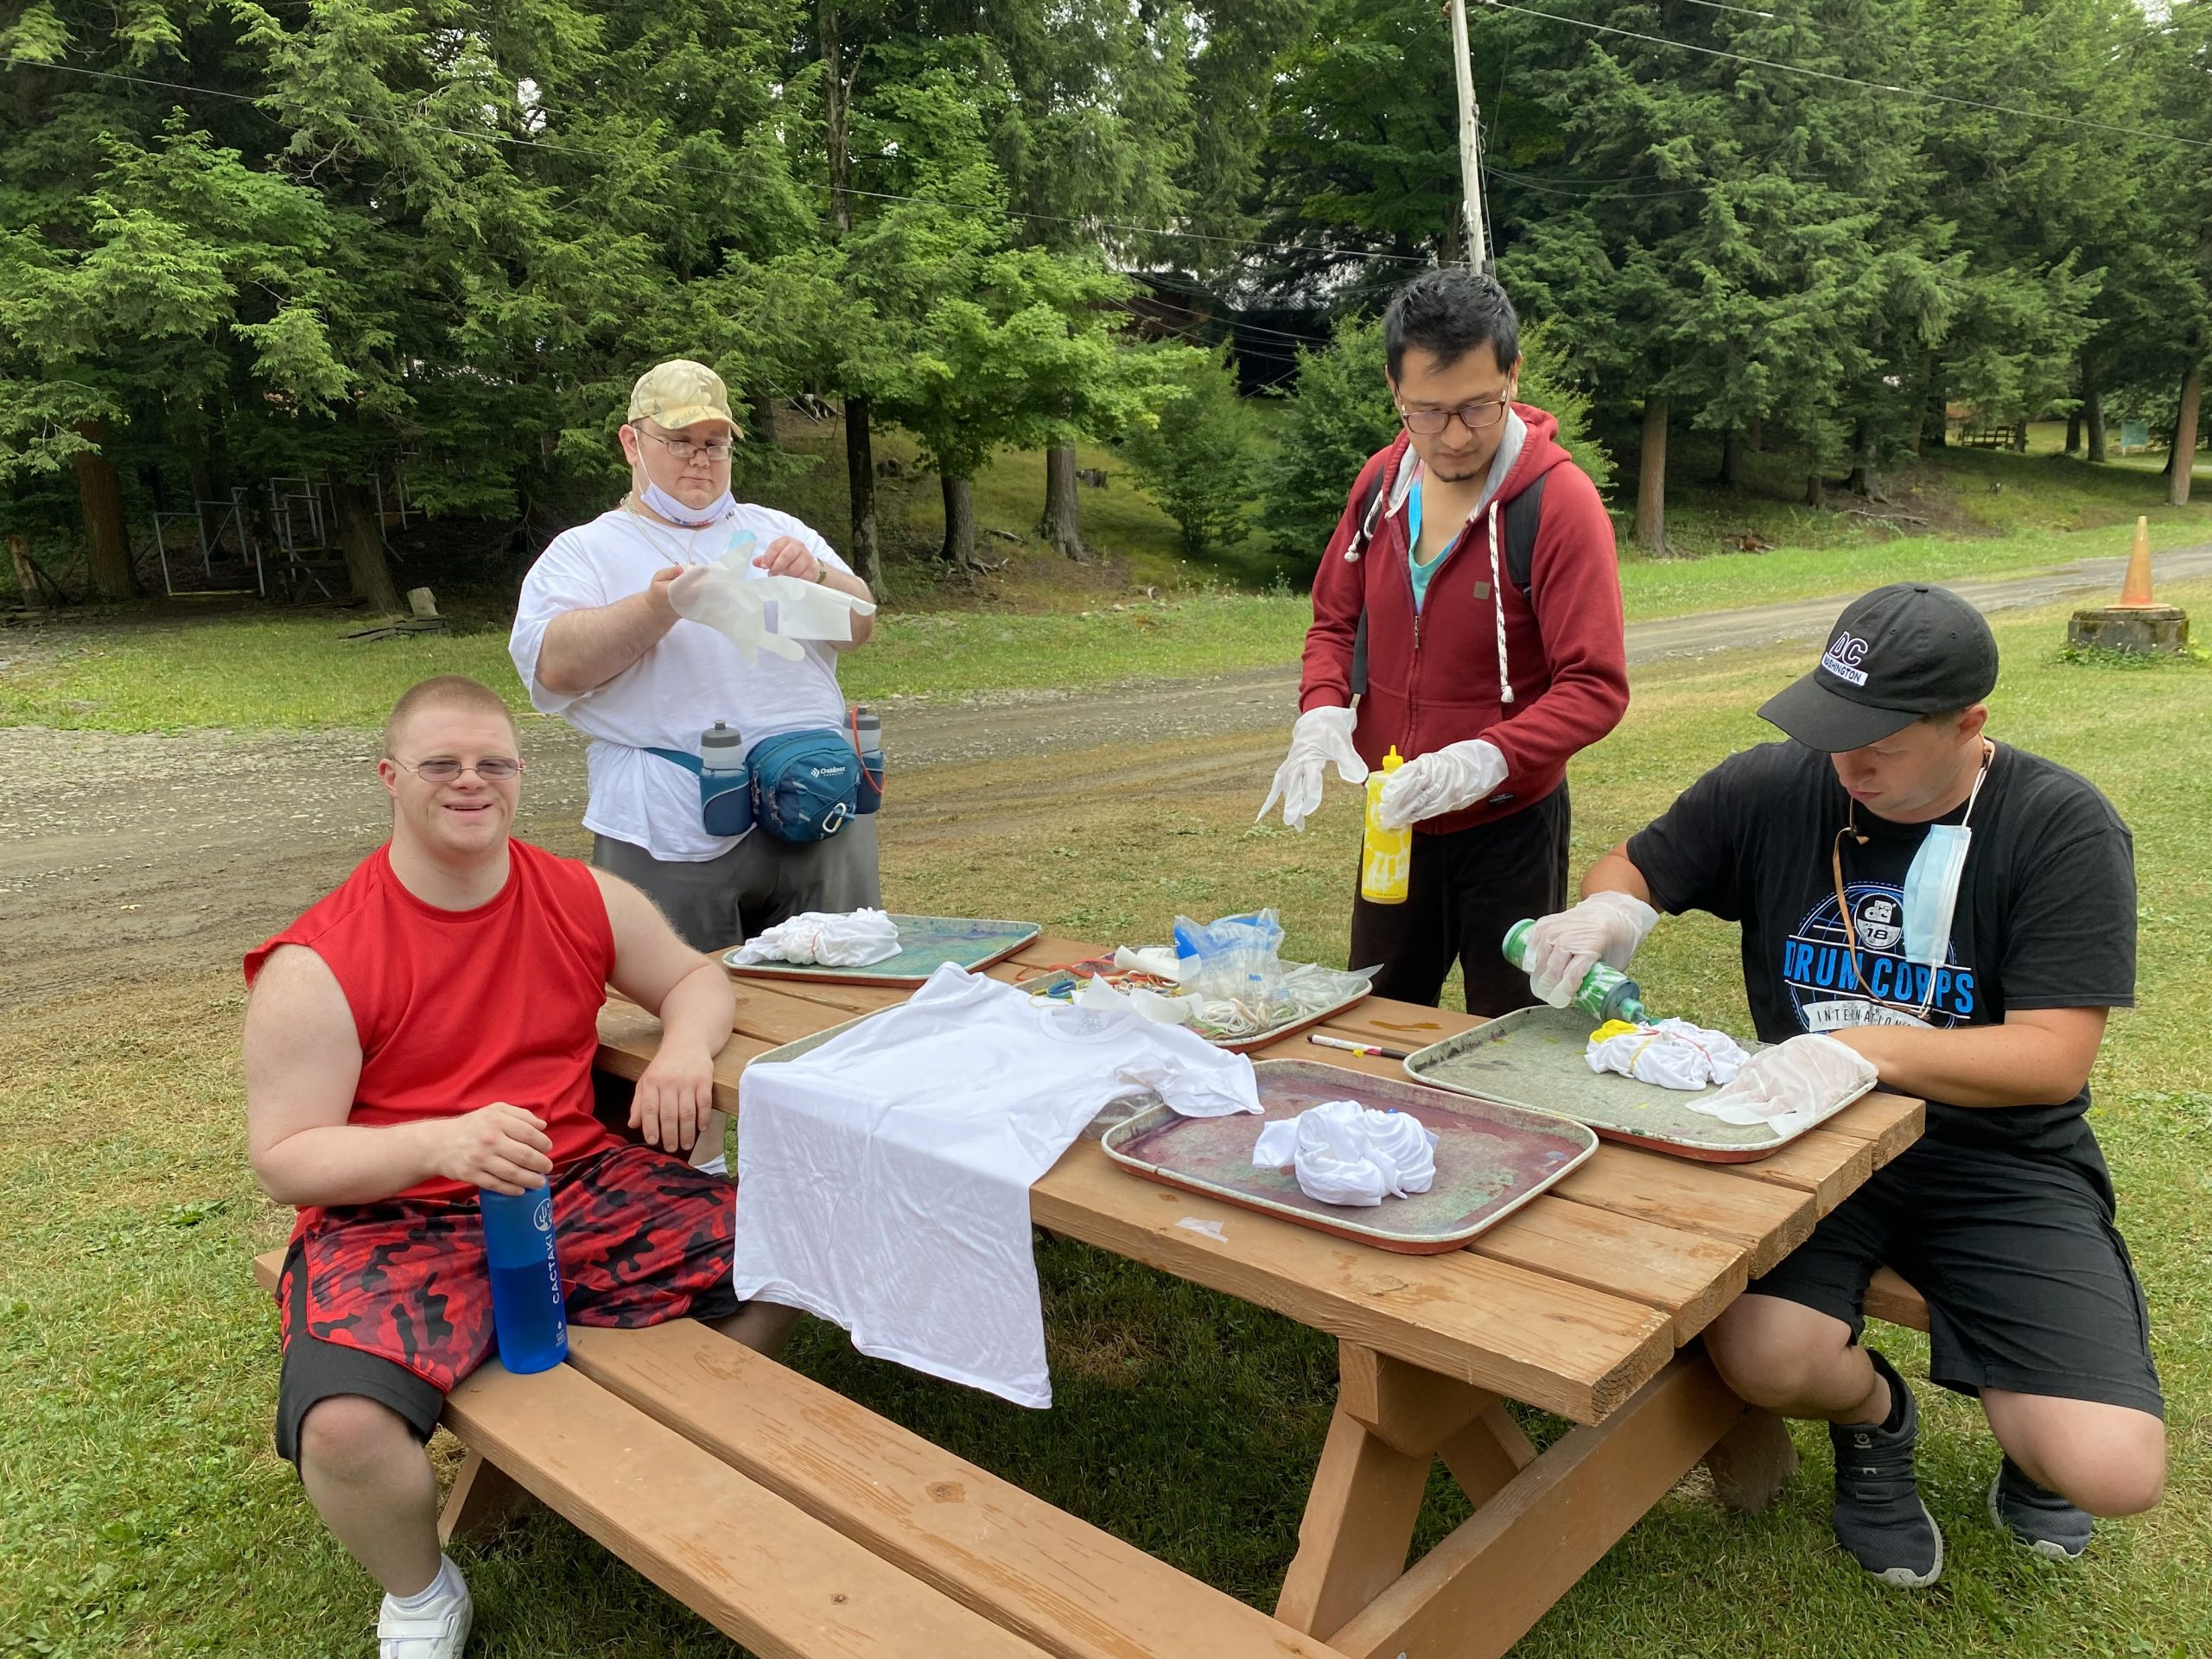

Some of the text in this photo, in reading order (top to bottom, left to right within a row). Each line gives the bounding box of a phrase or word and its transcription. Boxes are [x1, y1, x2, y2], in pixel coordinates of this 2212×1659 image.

[1828, 631, 1868, 666] DC
[1866, 927, 1889, 940] 18
[1783, 940, 1974, 1014] DRUM CORPS
[1817, 1008, 1912, 1026] INTENATION
[544, 1233, 561, 1305] CACTAKI
